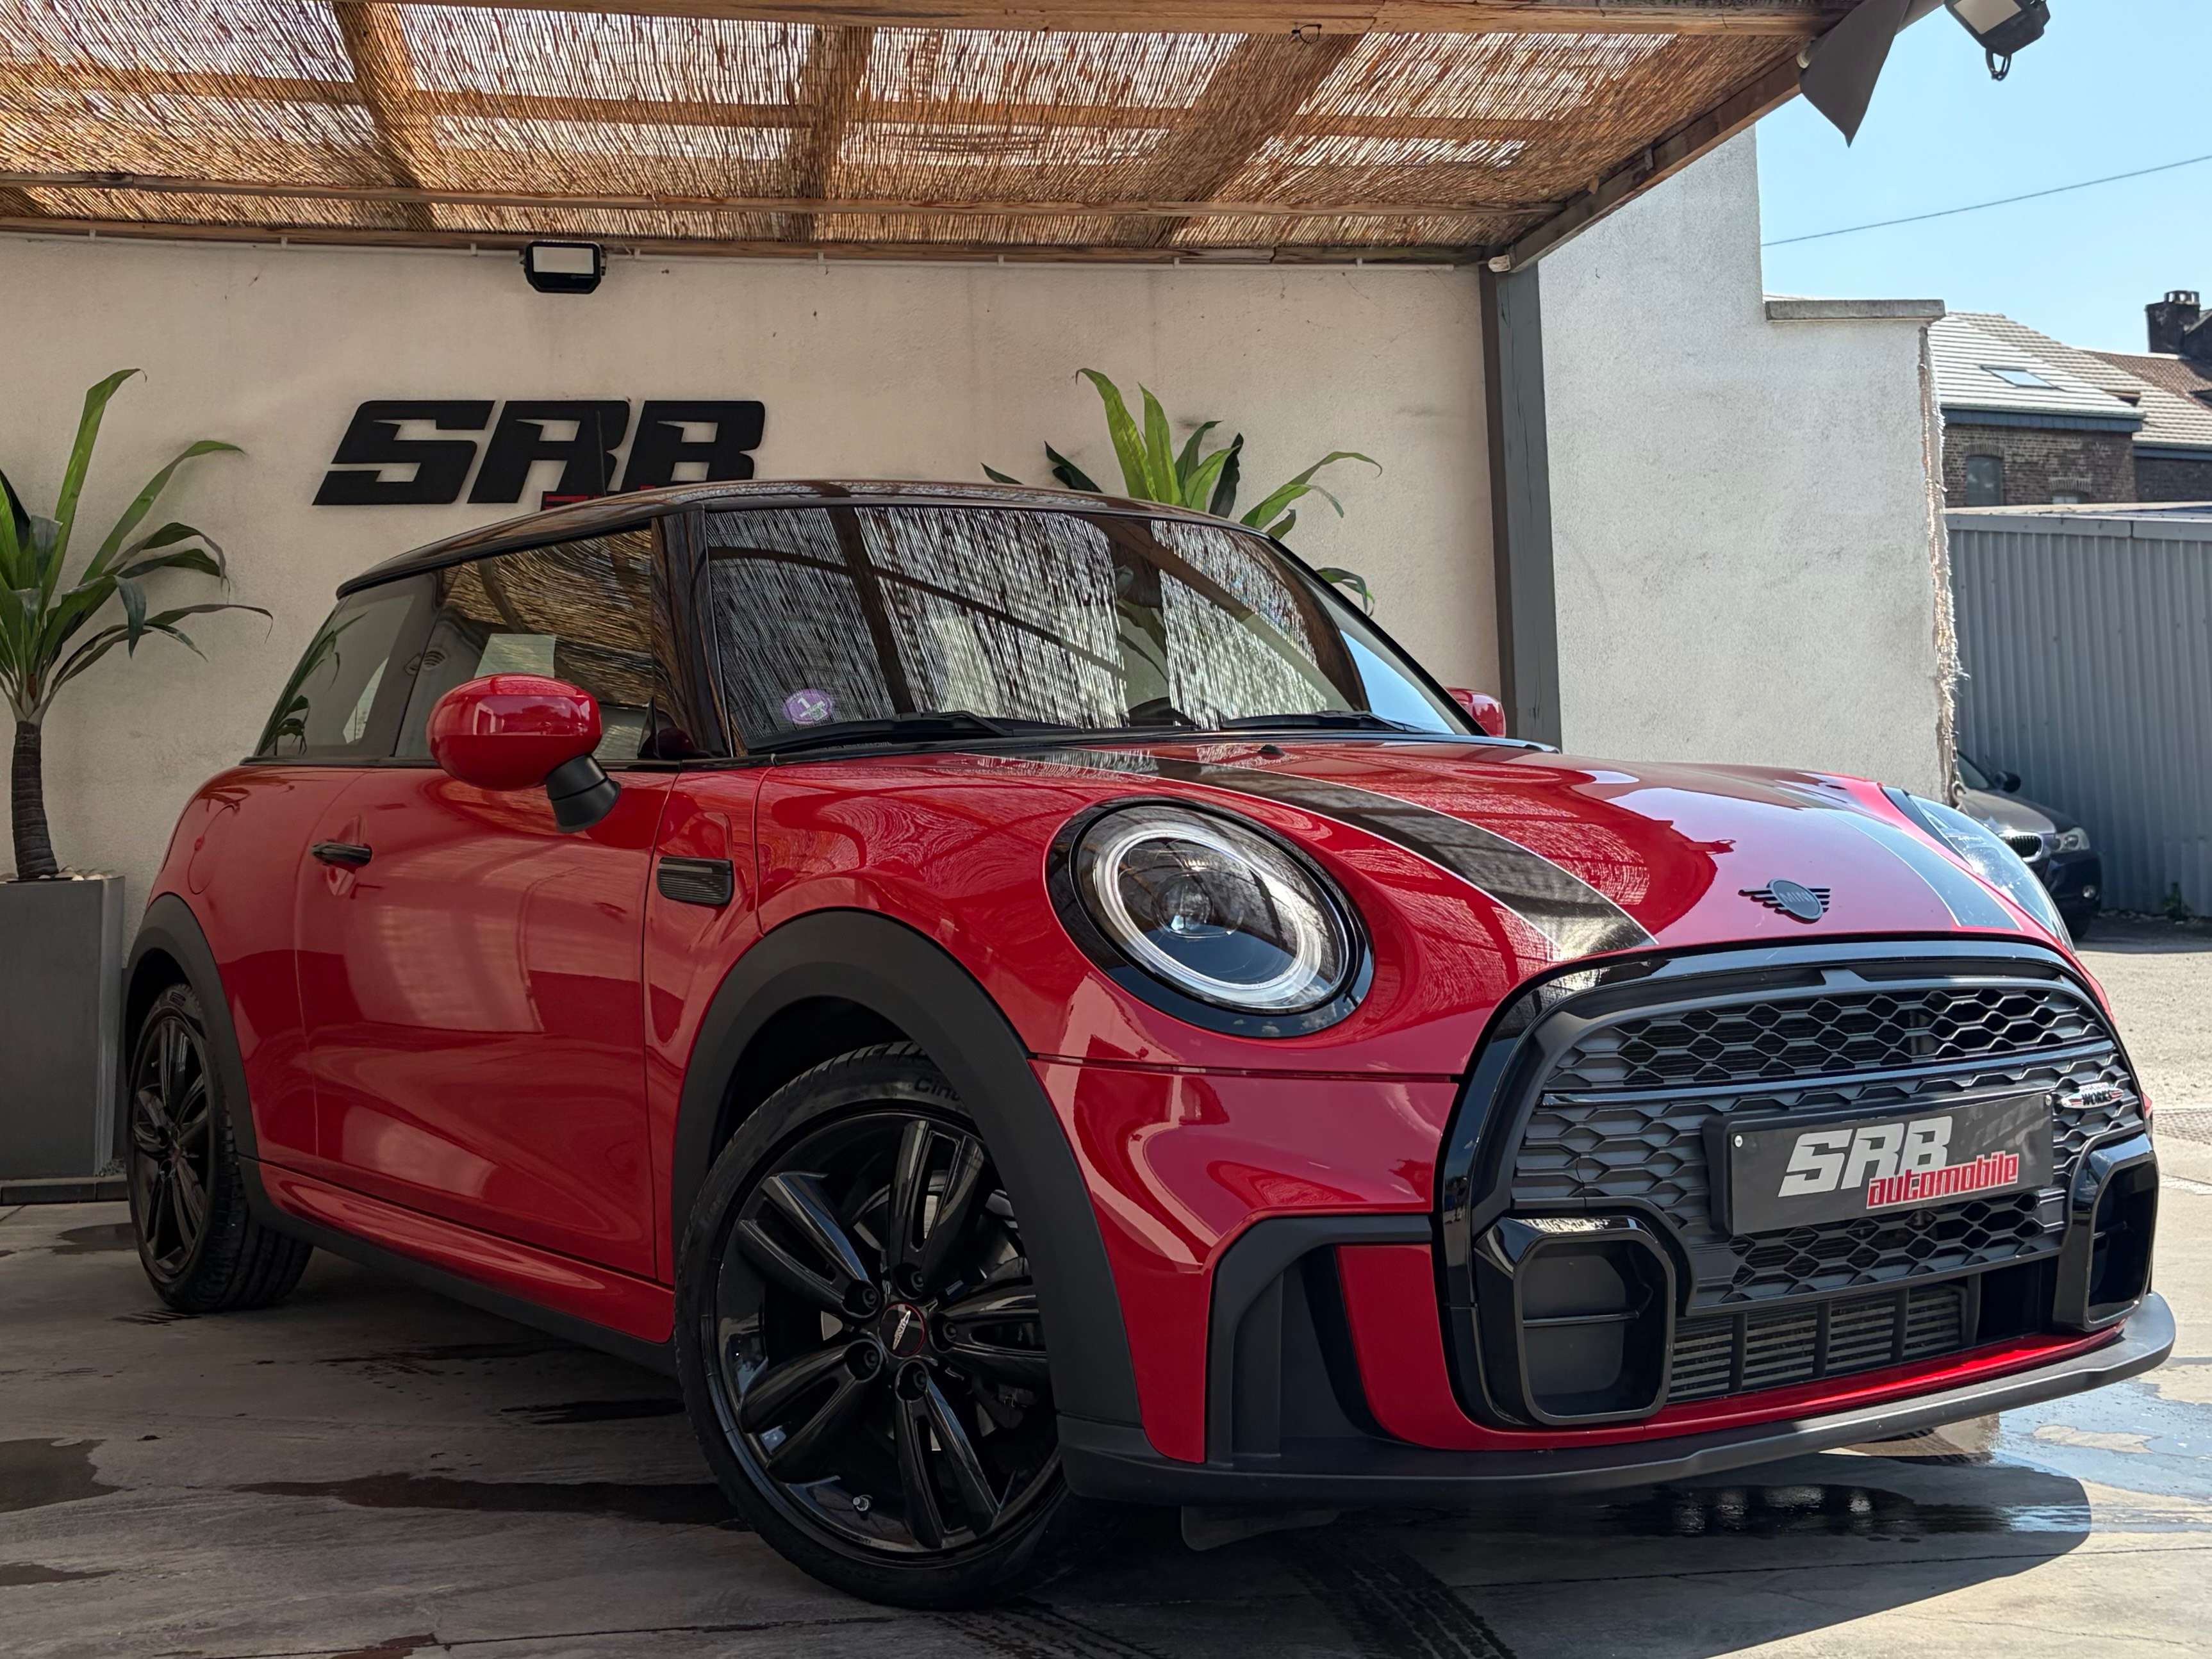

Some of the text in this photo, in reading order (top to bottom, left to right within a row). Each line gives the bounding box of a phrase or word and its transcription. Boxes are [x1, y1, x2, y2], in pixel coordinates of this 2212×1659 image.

[312, 400, 766, 505] SRB
[1779, 891, 1815, 903] MINI
[2081, 1090, 2113, 1106] WORKS
[1778, 1116, 1952, 1197] SRB
[1866, 1150, 2019, 1209] automobile
